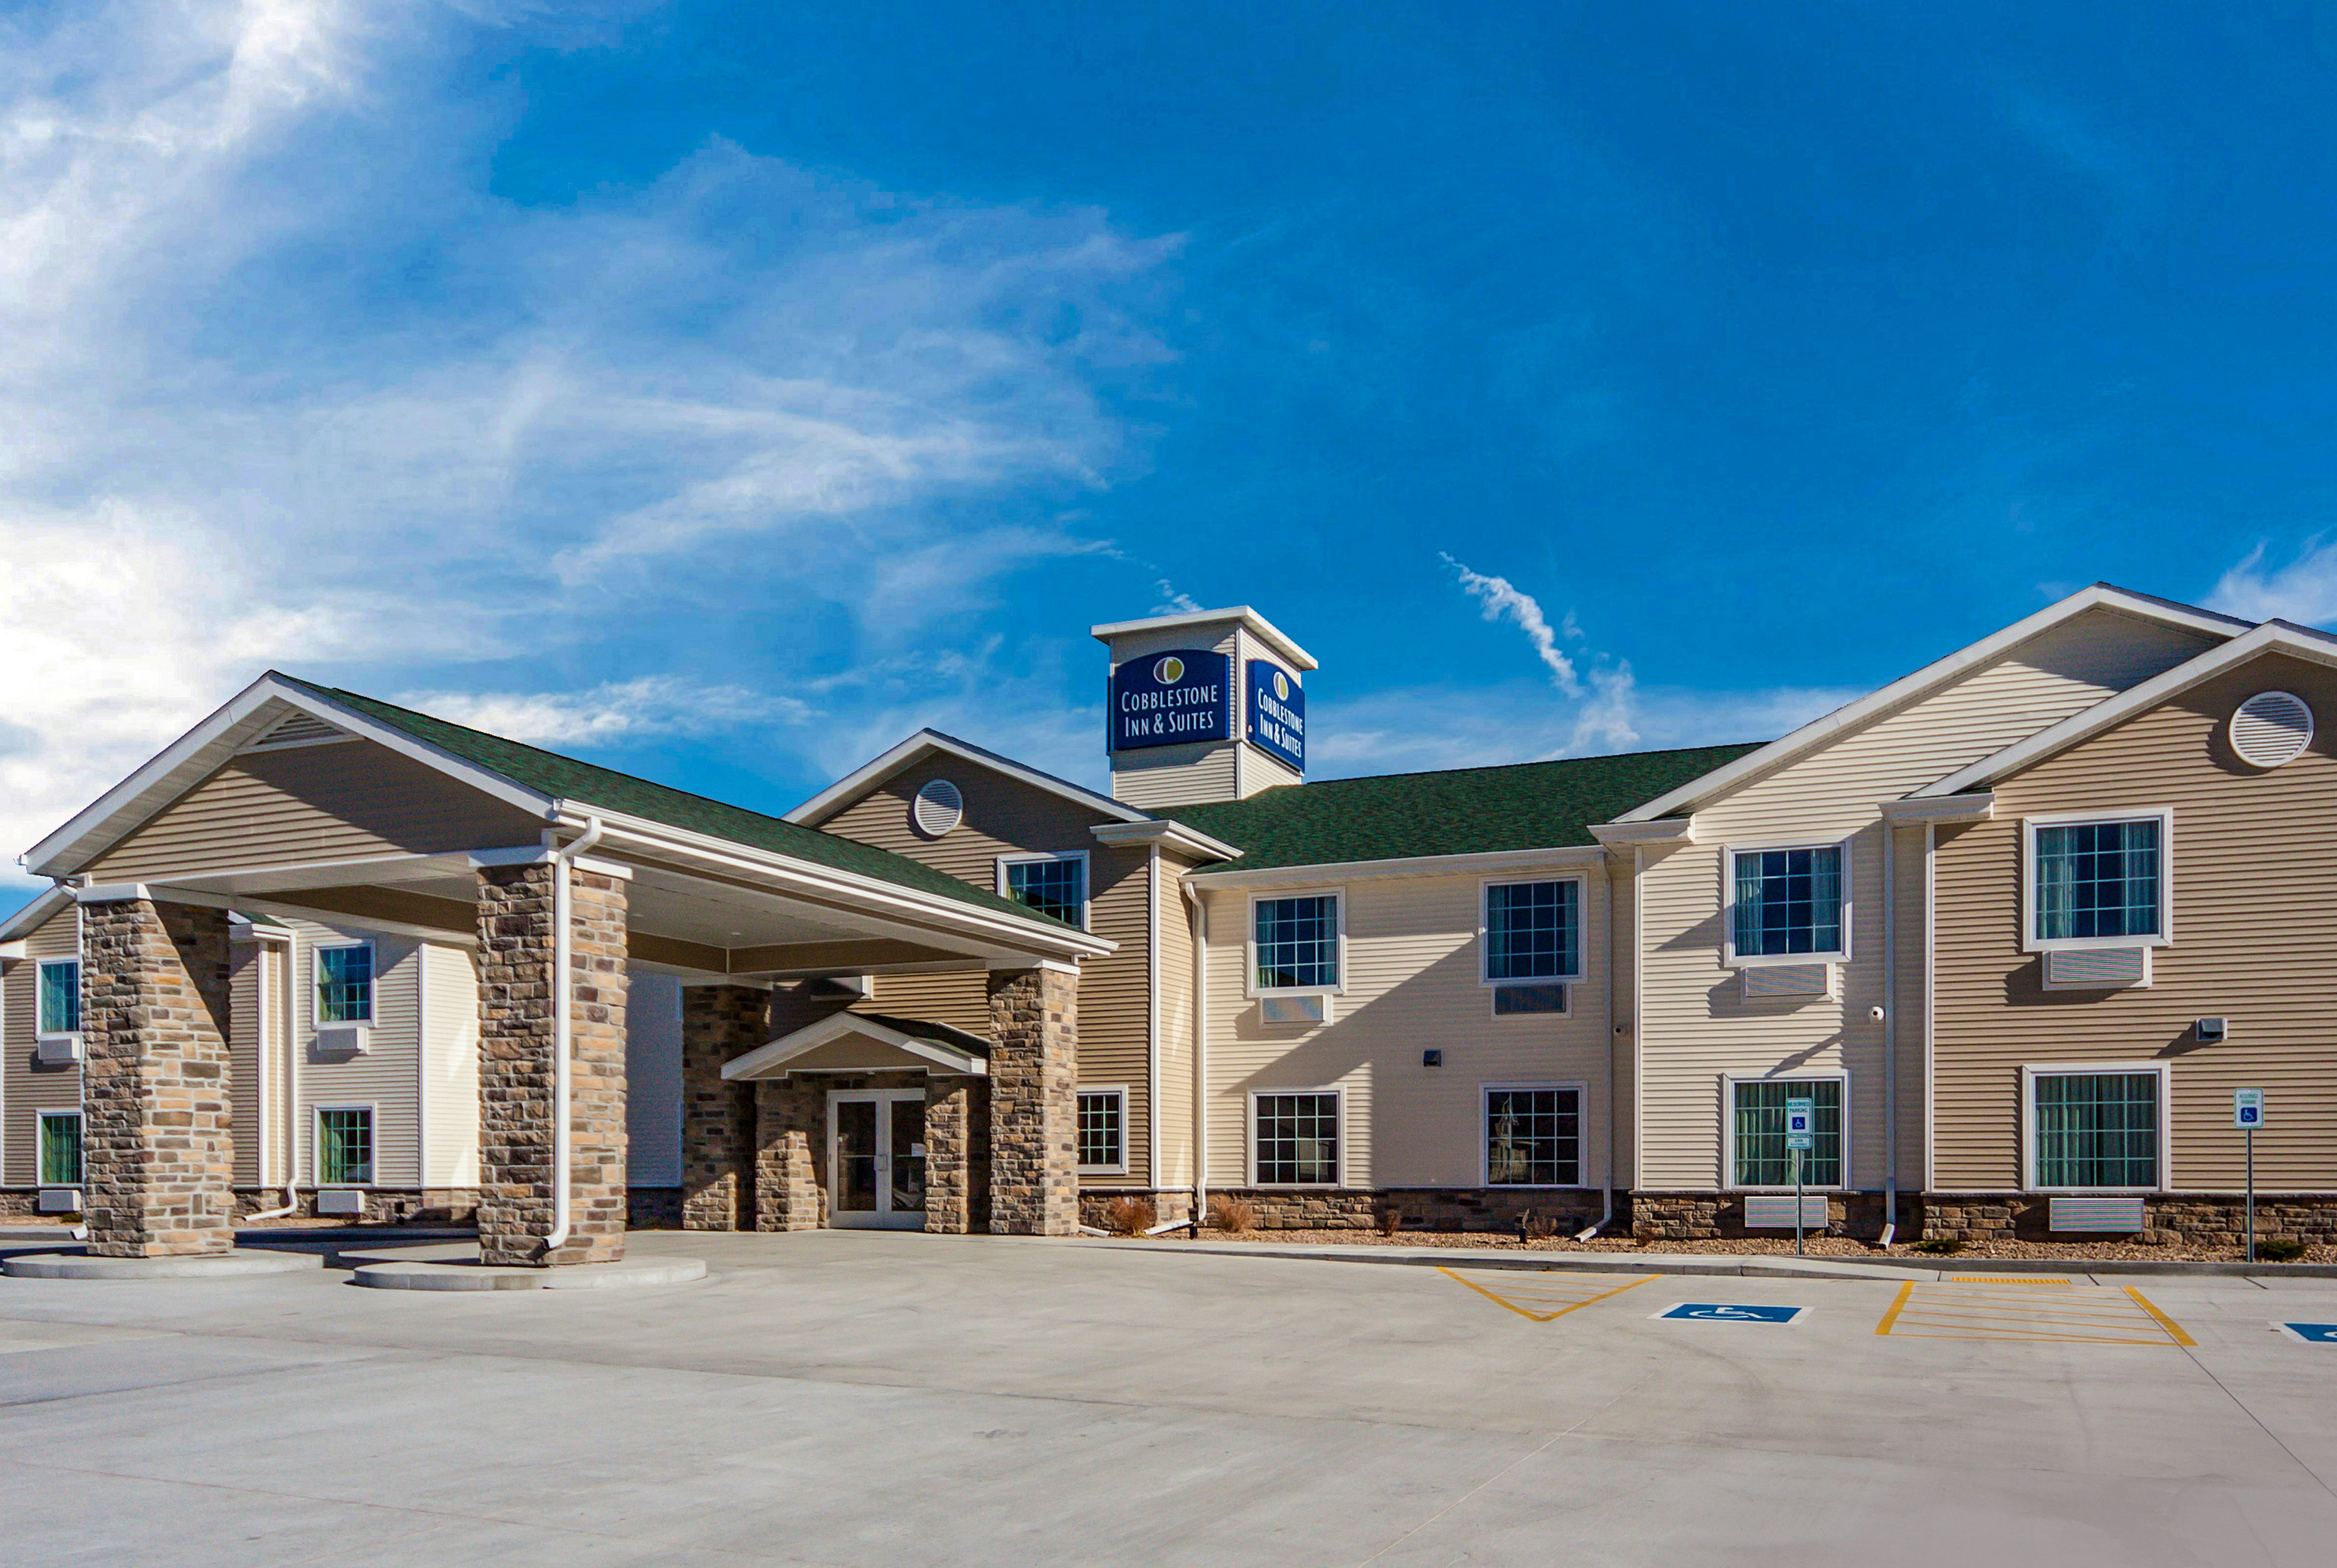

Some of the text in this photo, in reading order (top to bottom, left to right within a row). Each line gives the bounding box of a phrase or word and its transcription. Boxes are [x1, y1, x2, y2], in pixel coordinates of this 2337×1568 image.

[1122, 685, 1217, 712] COBBLESTONE
[1258, 688, 1303, 735] COBBLESTONE
[1125, 711, 1213, 737] INN & SUITES
[1260, 714, 1301, 758] INN & SUITES
